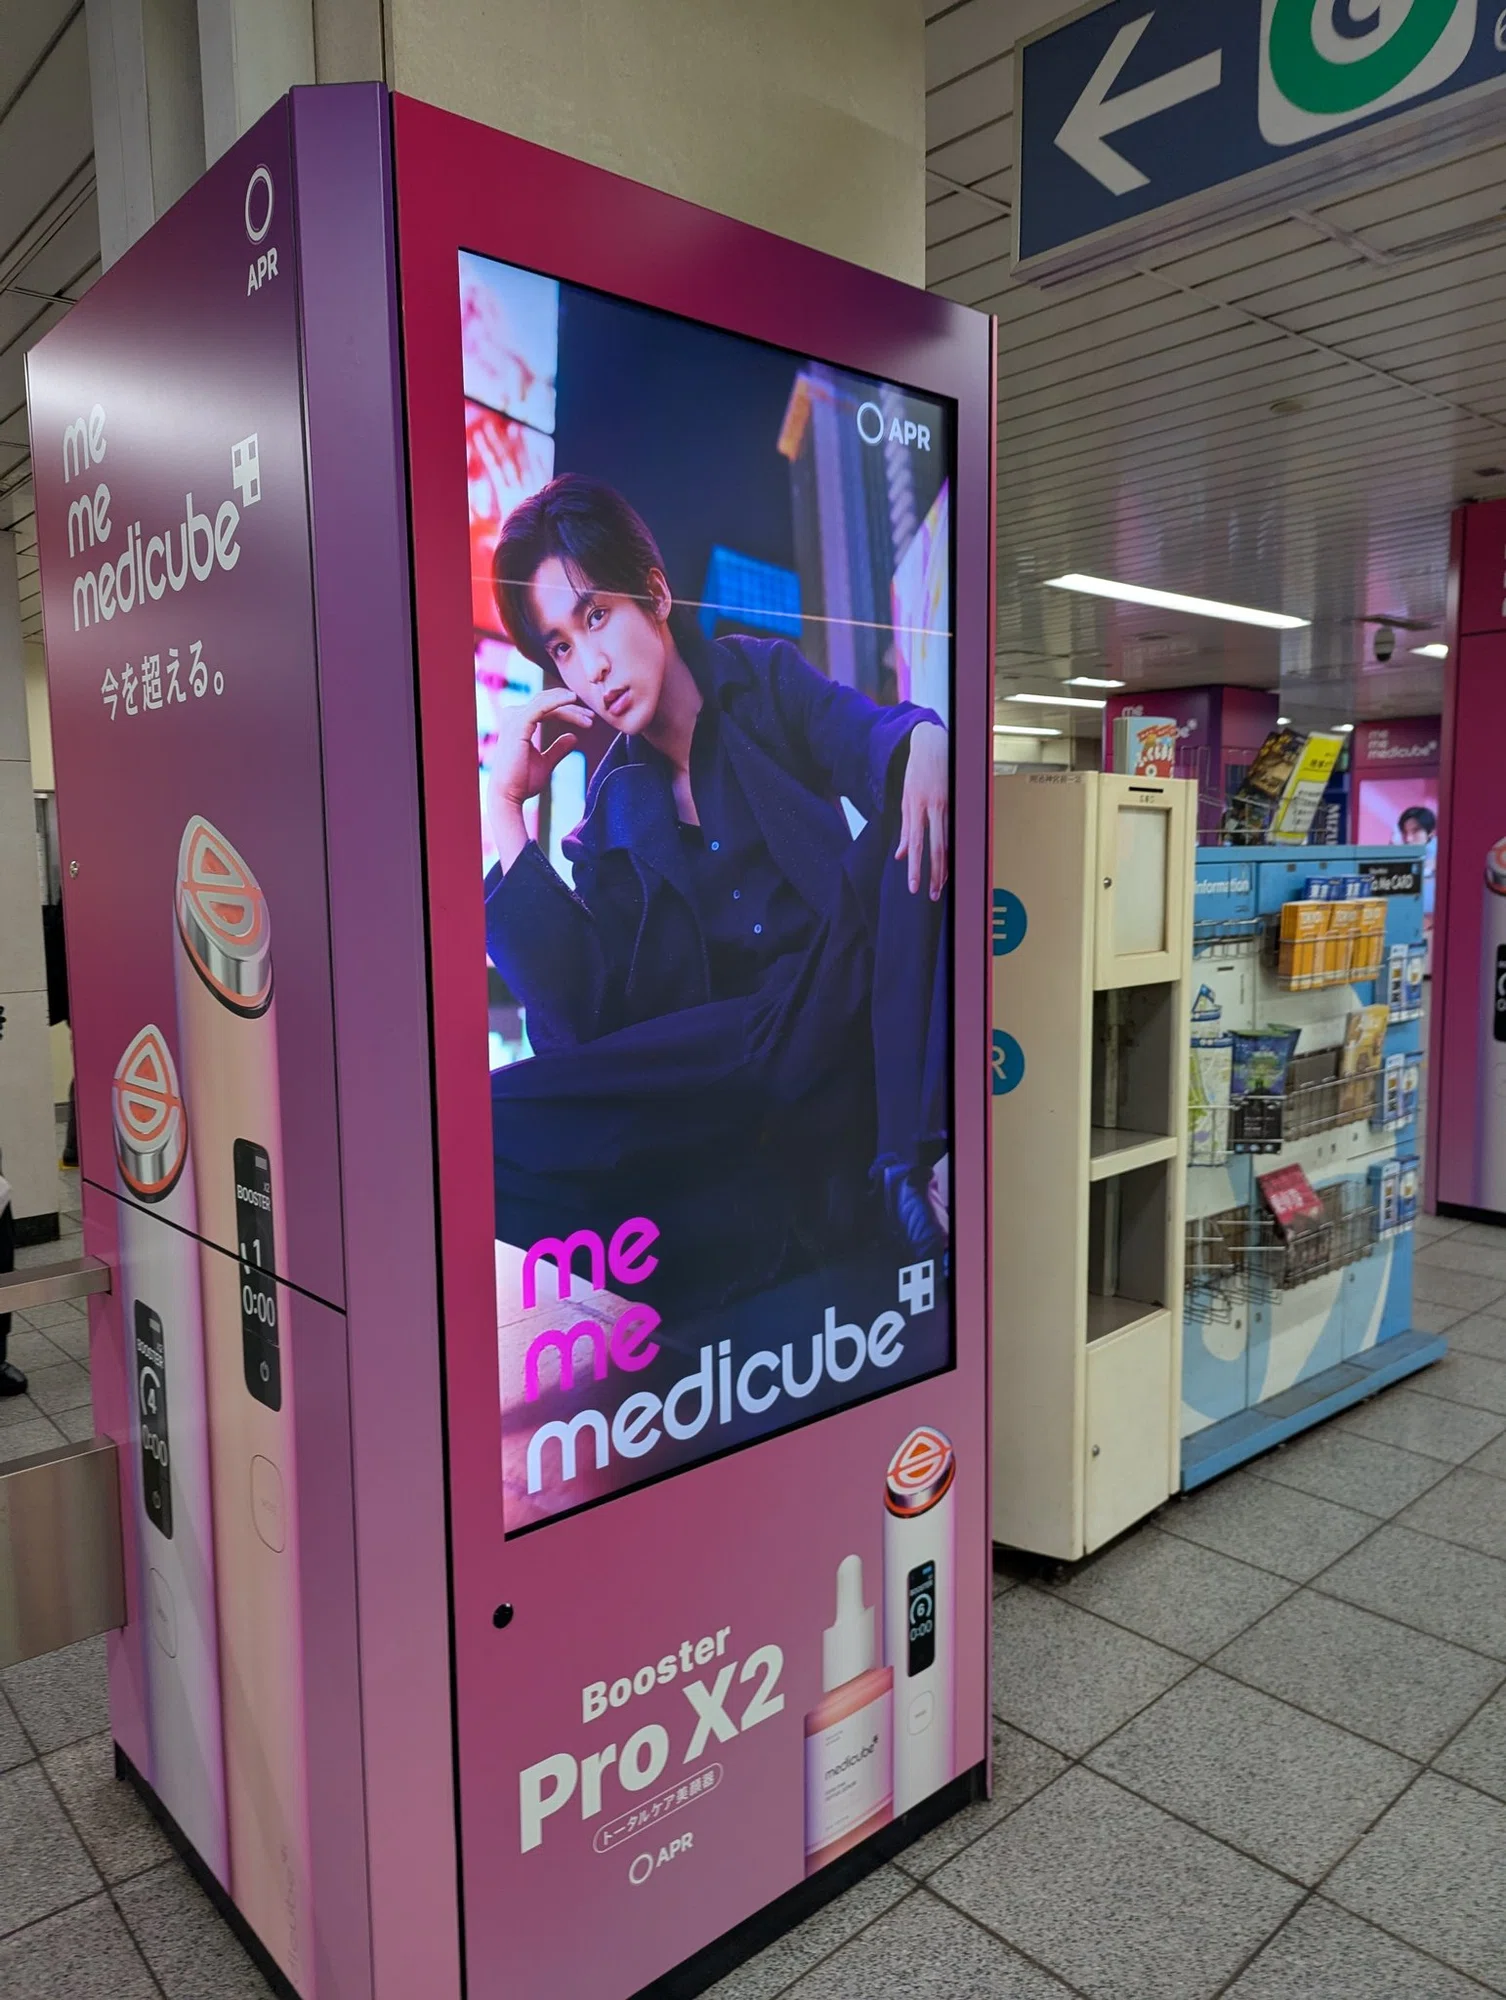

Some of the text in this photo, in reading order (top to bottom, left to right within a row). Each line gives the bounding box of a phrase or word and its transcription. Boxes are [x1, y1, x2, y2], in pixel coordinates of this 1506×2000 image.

[246, 246, 279, 296] APR
[62, 402, 107, 484] me
[887, 417, 932, 452] APR
[67, 482, 111, 558] me
[72, 491, 241, 632] medicube
[101, 639, 224, 721] 今を超える。
[236, 1183, 271, 1213] BOOSTER
[522, 1216, 661, 1310] me
[243, 1285, 276, 1327] 0:00
[524, 1303, 662, 1402] me
[526, 1306, 906, 1495] medicube
[582, 1626, 731, 1724] Booster
[519, 1644, 785, 1854] Pro X2
[656, 1832, 694, 1868] APR
